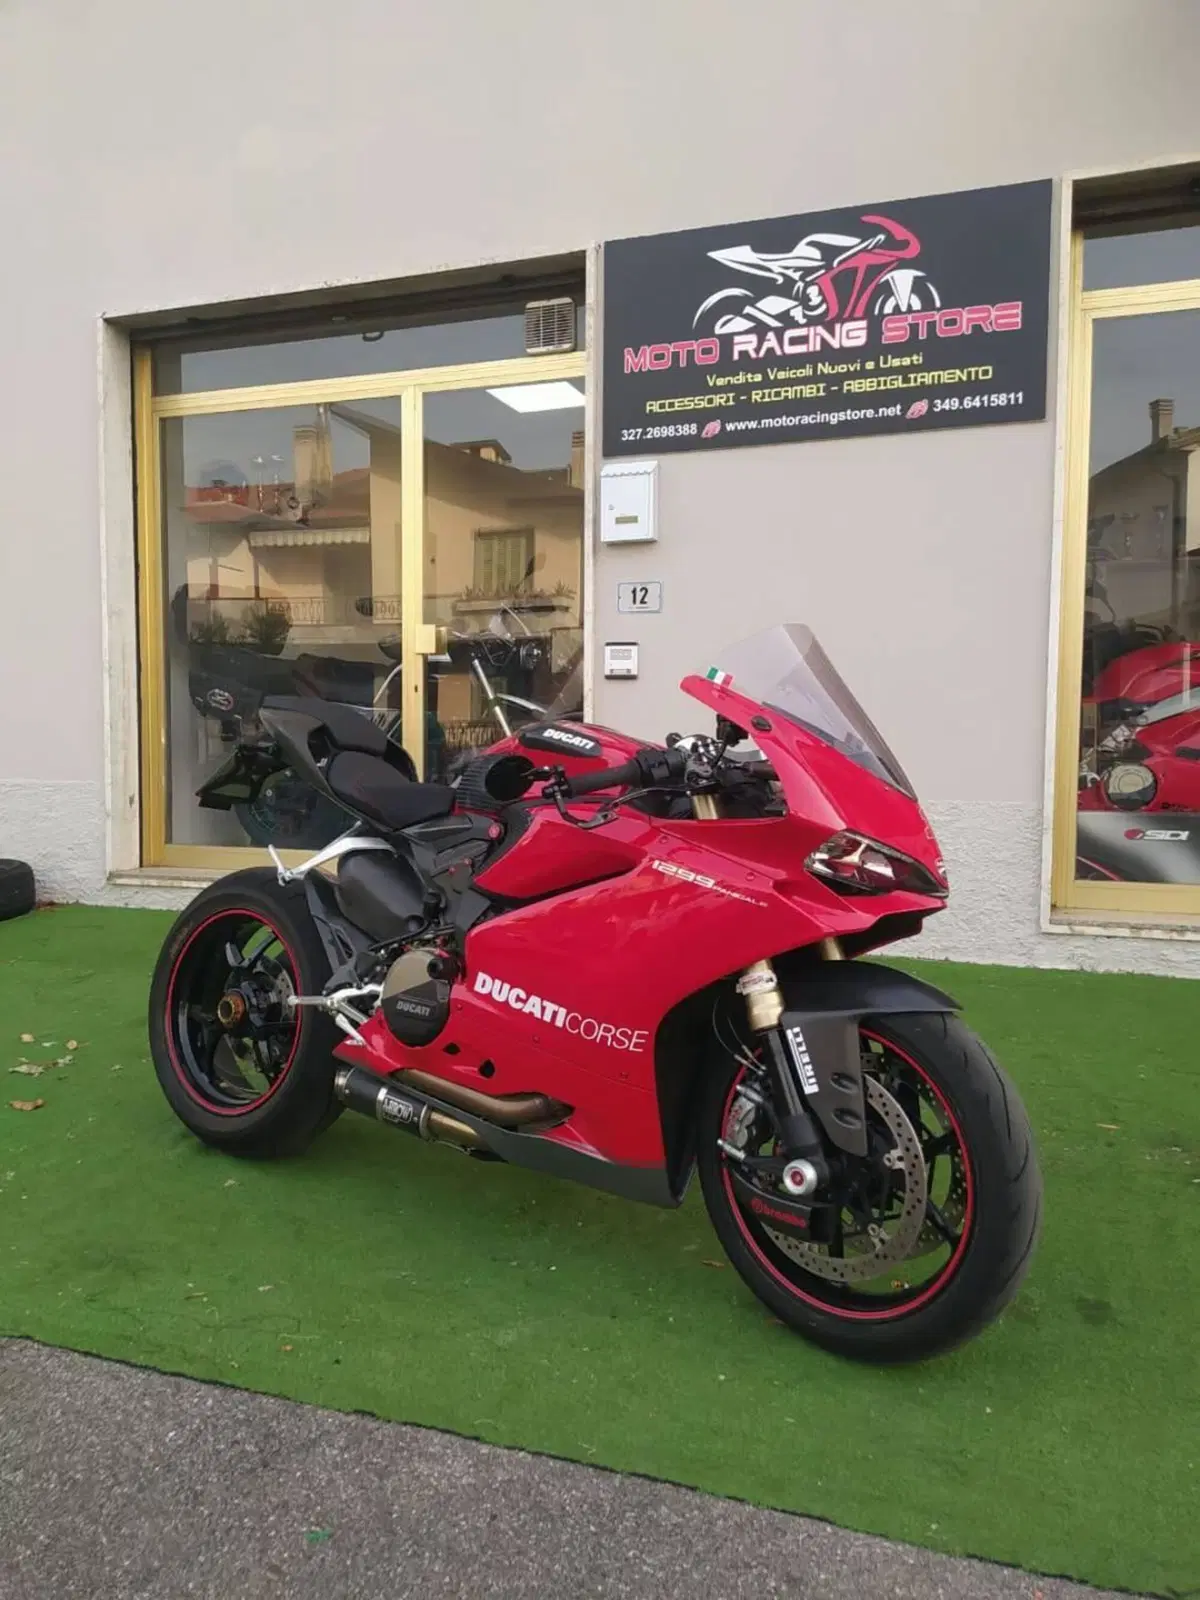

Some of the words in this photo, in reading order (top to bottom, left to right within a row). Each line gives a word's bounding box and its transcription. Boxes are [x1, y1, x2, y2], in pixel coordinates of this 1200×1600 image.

[624, 337, 720, 374] MOTO
[733, 320, 868, 361] RACING
[881, 301, 1022, 344] STORE
[645, 392, 736, 414] ACCESSORI
[751, 382, 827, 404] RICAMBI
[843, 366, 993, 394] ABBIGLIAMENTO
[706, 370, 763, 387] Vendita
[767, 364, 814, 381] Veicoli
[817, 358, 861, 377] Nuovi
[865, 361, 875, 370] e
[879, 352, 924, 369] Usati
[621, 423, 698, 441] 327.2698388
[725, 404, 902, 425] www.motoracingstore.net
[932, 391, 1024, 412] 349.6415811
[630, 586, 649, 605] 12
[542, 728, 595, 750] DUCATI
[651, 859, 716, 889] 1299
[395, 1000, 432, 1016] DUCATI
[473, 971, 567, 1028] DUCATI
[564, 1012, 649, 1052] CORSE
[785, 1026, 820, 1095] PIRELLI
